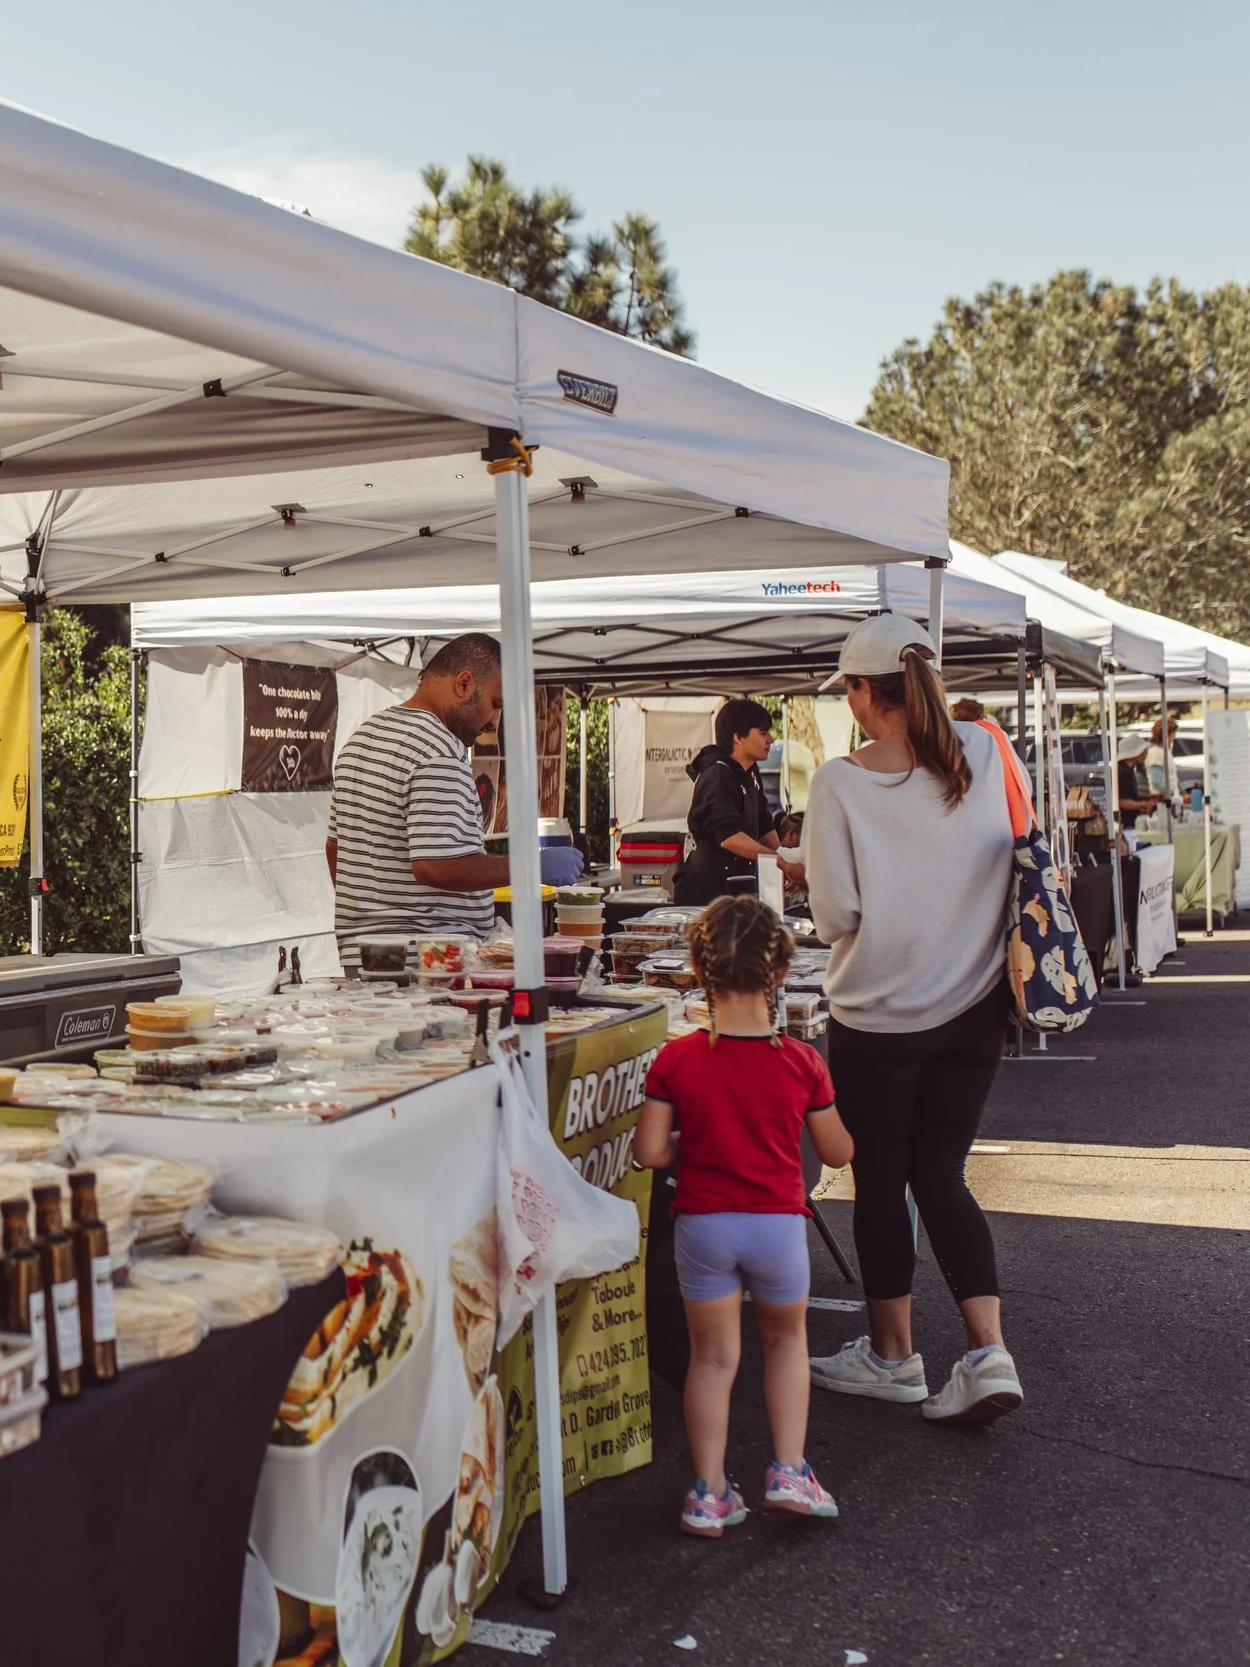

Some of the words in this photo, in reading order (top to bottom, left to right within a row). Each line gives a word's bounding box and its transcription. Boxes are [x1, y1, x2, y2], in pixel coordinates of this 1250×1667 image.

[761, 580, 841, 596] Yaheetech
[278, 686, 310, 700] chocolate
[275, 707, 292, 719] 100%
[293, 710, 299, 719] a
[250, 725, 274, 740] keeps
[275, 727, 286, 738] the
[0, 824, 7, 837] CA
[64, 1016, 101, 1036] Coleman
[563, 1047, 657, 1143] BROTHE
[592, 1313, 604, 1333] &
[570, 1413, 583, 1434] D.
